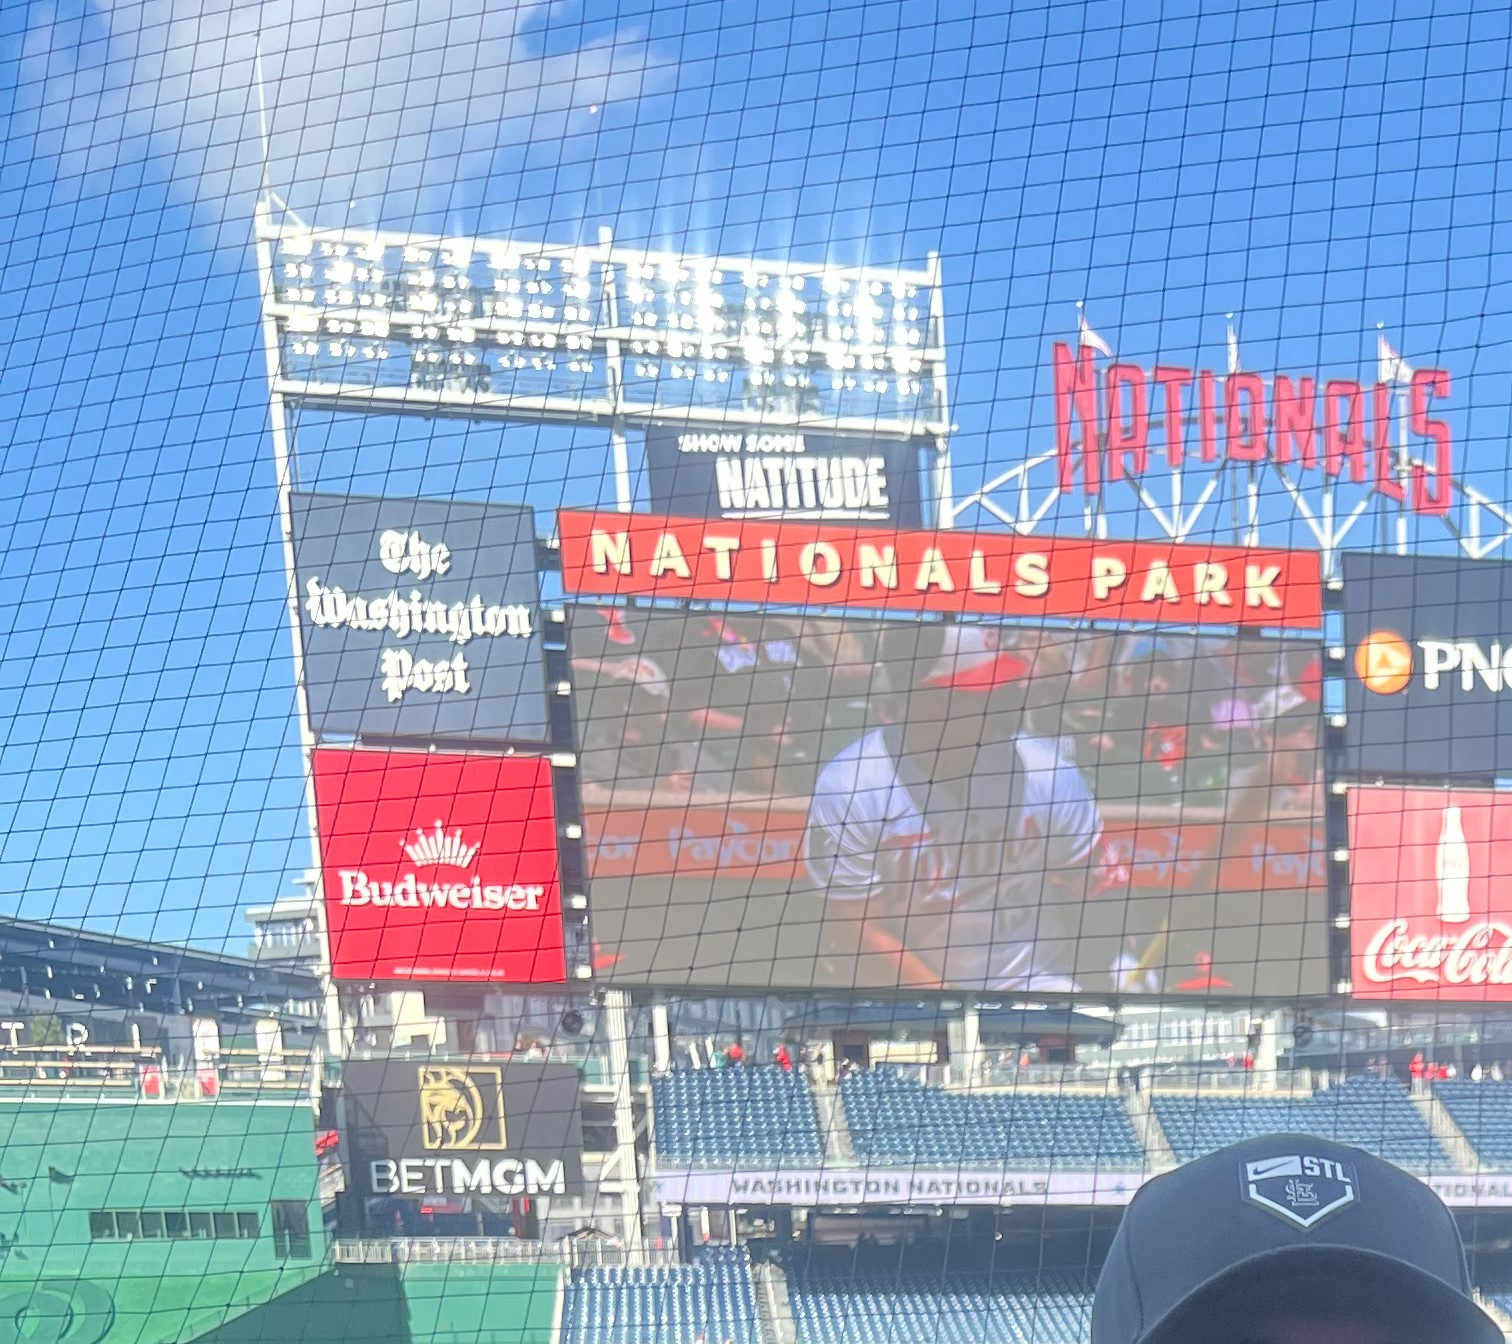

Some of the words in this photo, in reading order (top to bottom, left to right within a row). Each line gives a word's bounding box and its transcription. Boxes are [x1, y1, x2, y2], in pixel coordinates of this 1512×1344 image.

[678, 434, 743, 453] SHOW
[1053, 341, 1452, 516] NATIONALS
[716, 456, 890, 510] NATITUDE
[379, 529, 451, 580] The
[591, 527, 1050, 597] NATIONALS
[1092, 555, 1284, 609] PARK
[305, 576, 533, 645] Washington
[381, 648, 471, 702] Post
[338, 869, 546, 911] Budweiser
[369, 1158, 567, 1194] BETMGM
[732, 1176, 899, 1196] WASHINGTON
[909, 1178, 1048, 1197] NATIONALS
[1302, 1155, 1352, 1183] STL
